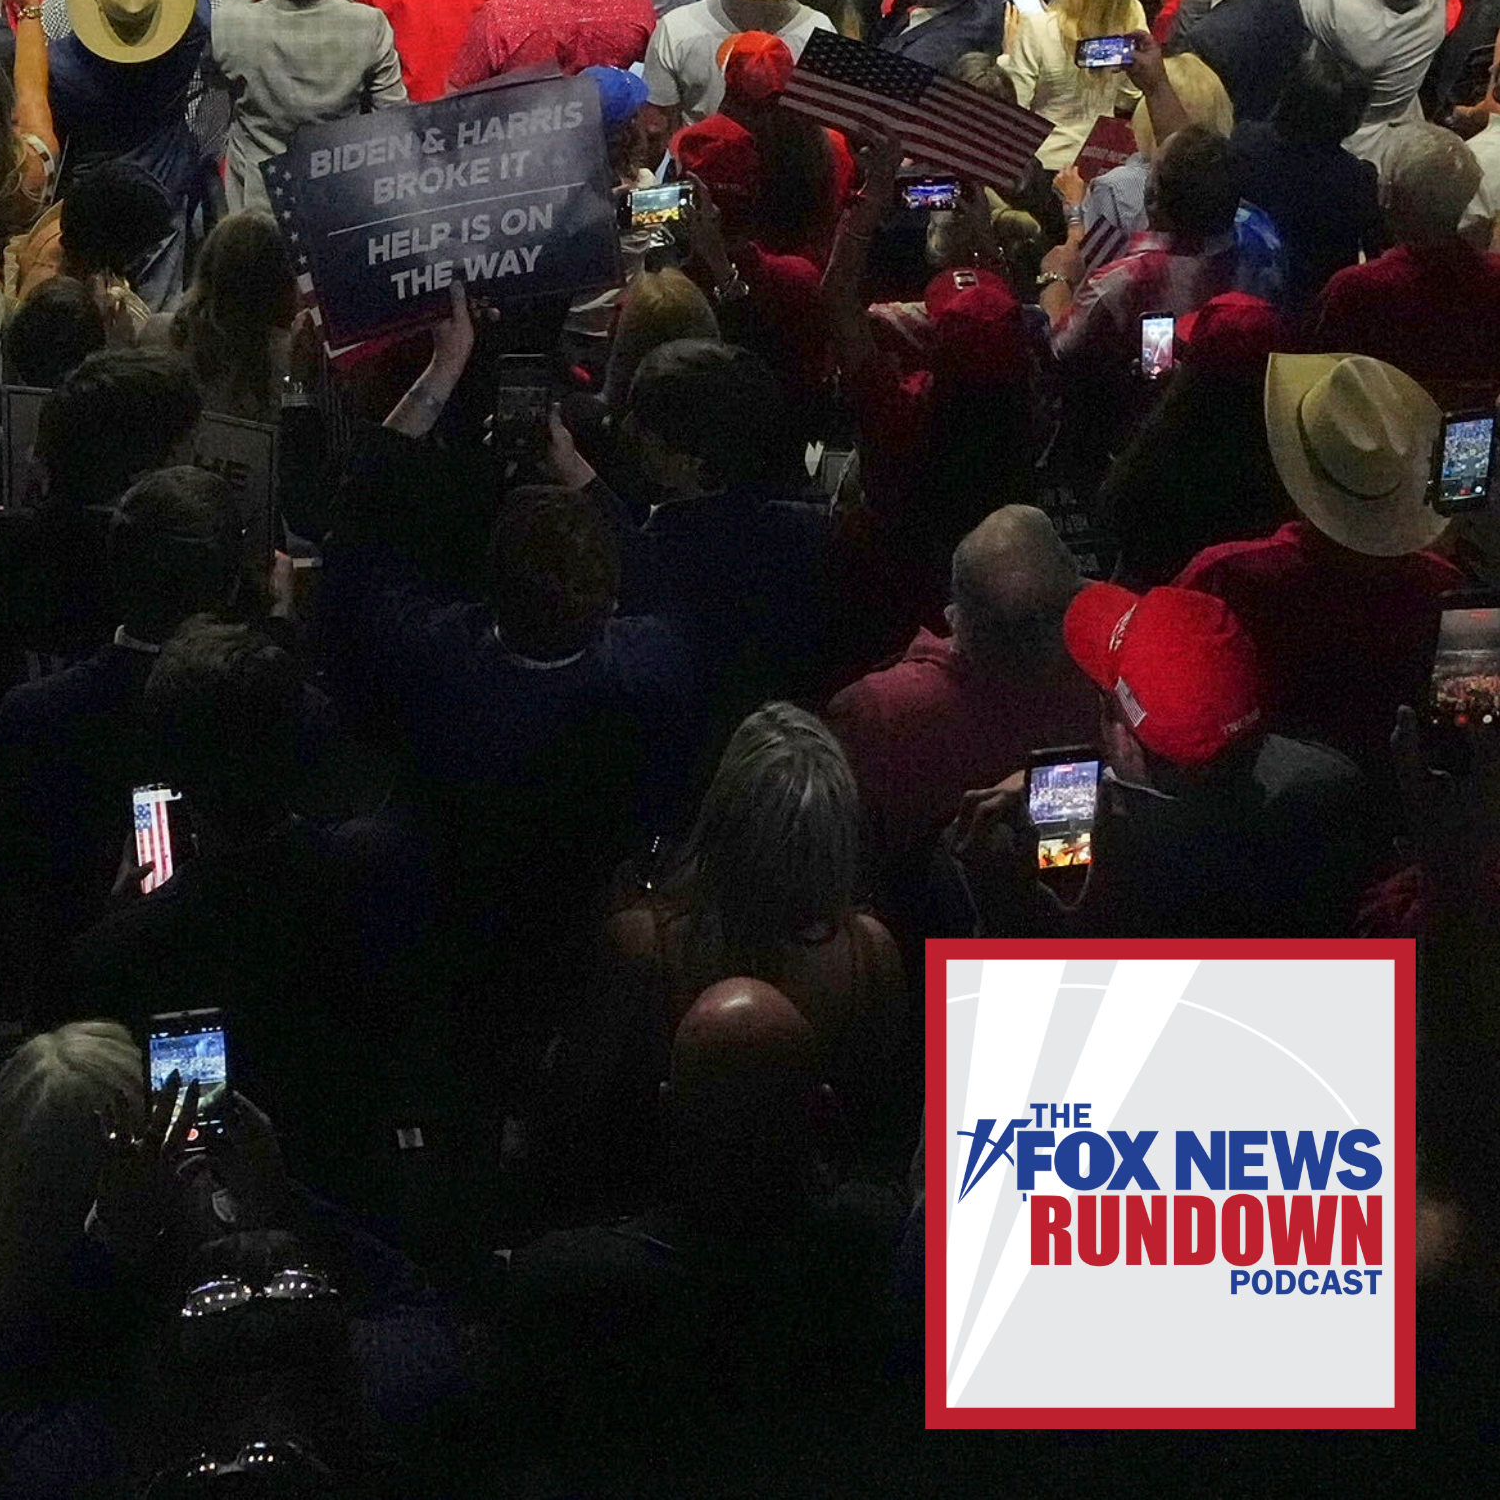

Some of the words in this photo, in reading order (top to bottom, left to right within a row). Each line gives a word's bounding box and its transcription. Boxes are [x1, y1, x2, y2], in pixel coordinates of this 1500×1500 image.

[310, 131, 416, 180] BIDEN
[421, 128, 446, 155] &
[457, 101, 584, 149] HARRIS
[373, 158, 491, 206] BROKE
[499, 150, 533, 181] IT
[368, 222, 453, 266] HELP
[461, 214, 491, 244] IS
[500, 203, 555, 236] ON
[390, 260, 455, 301] THE
[463, 244, 544, 283] WAY
